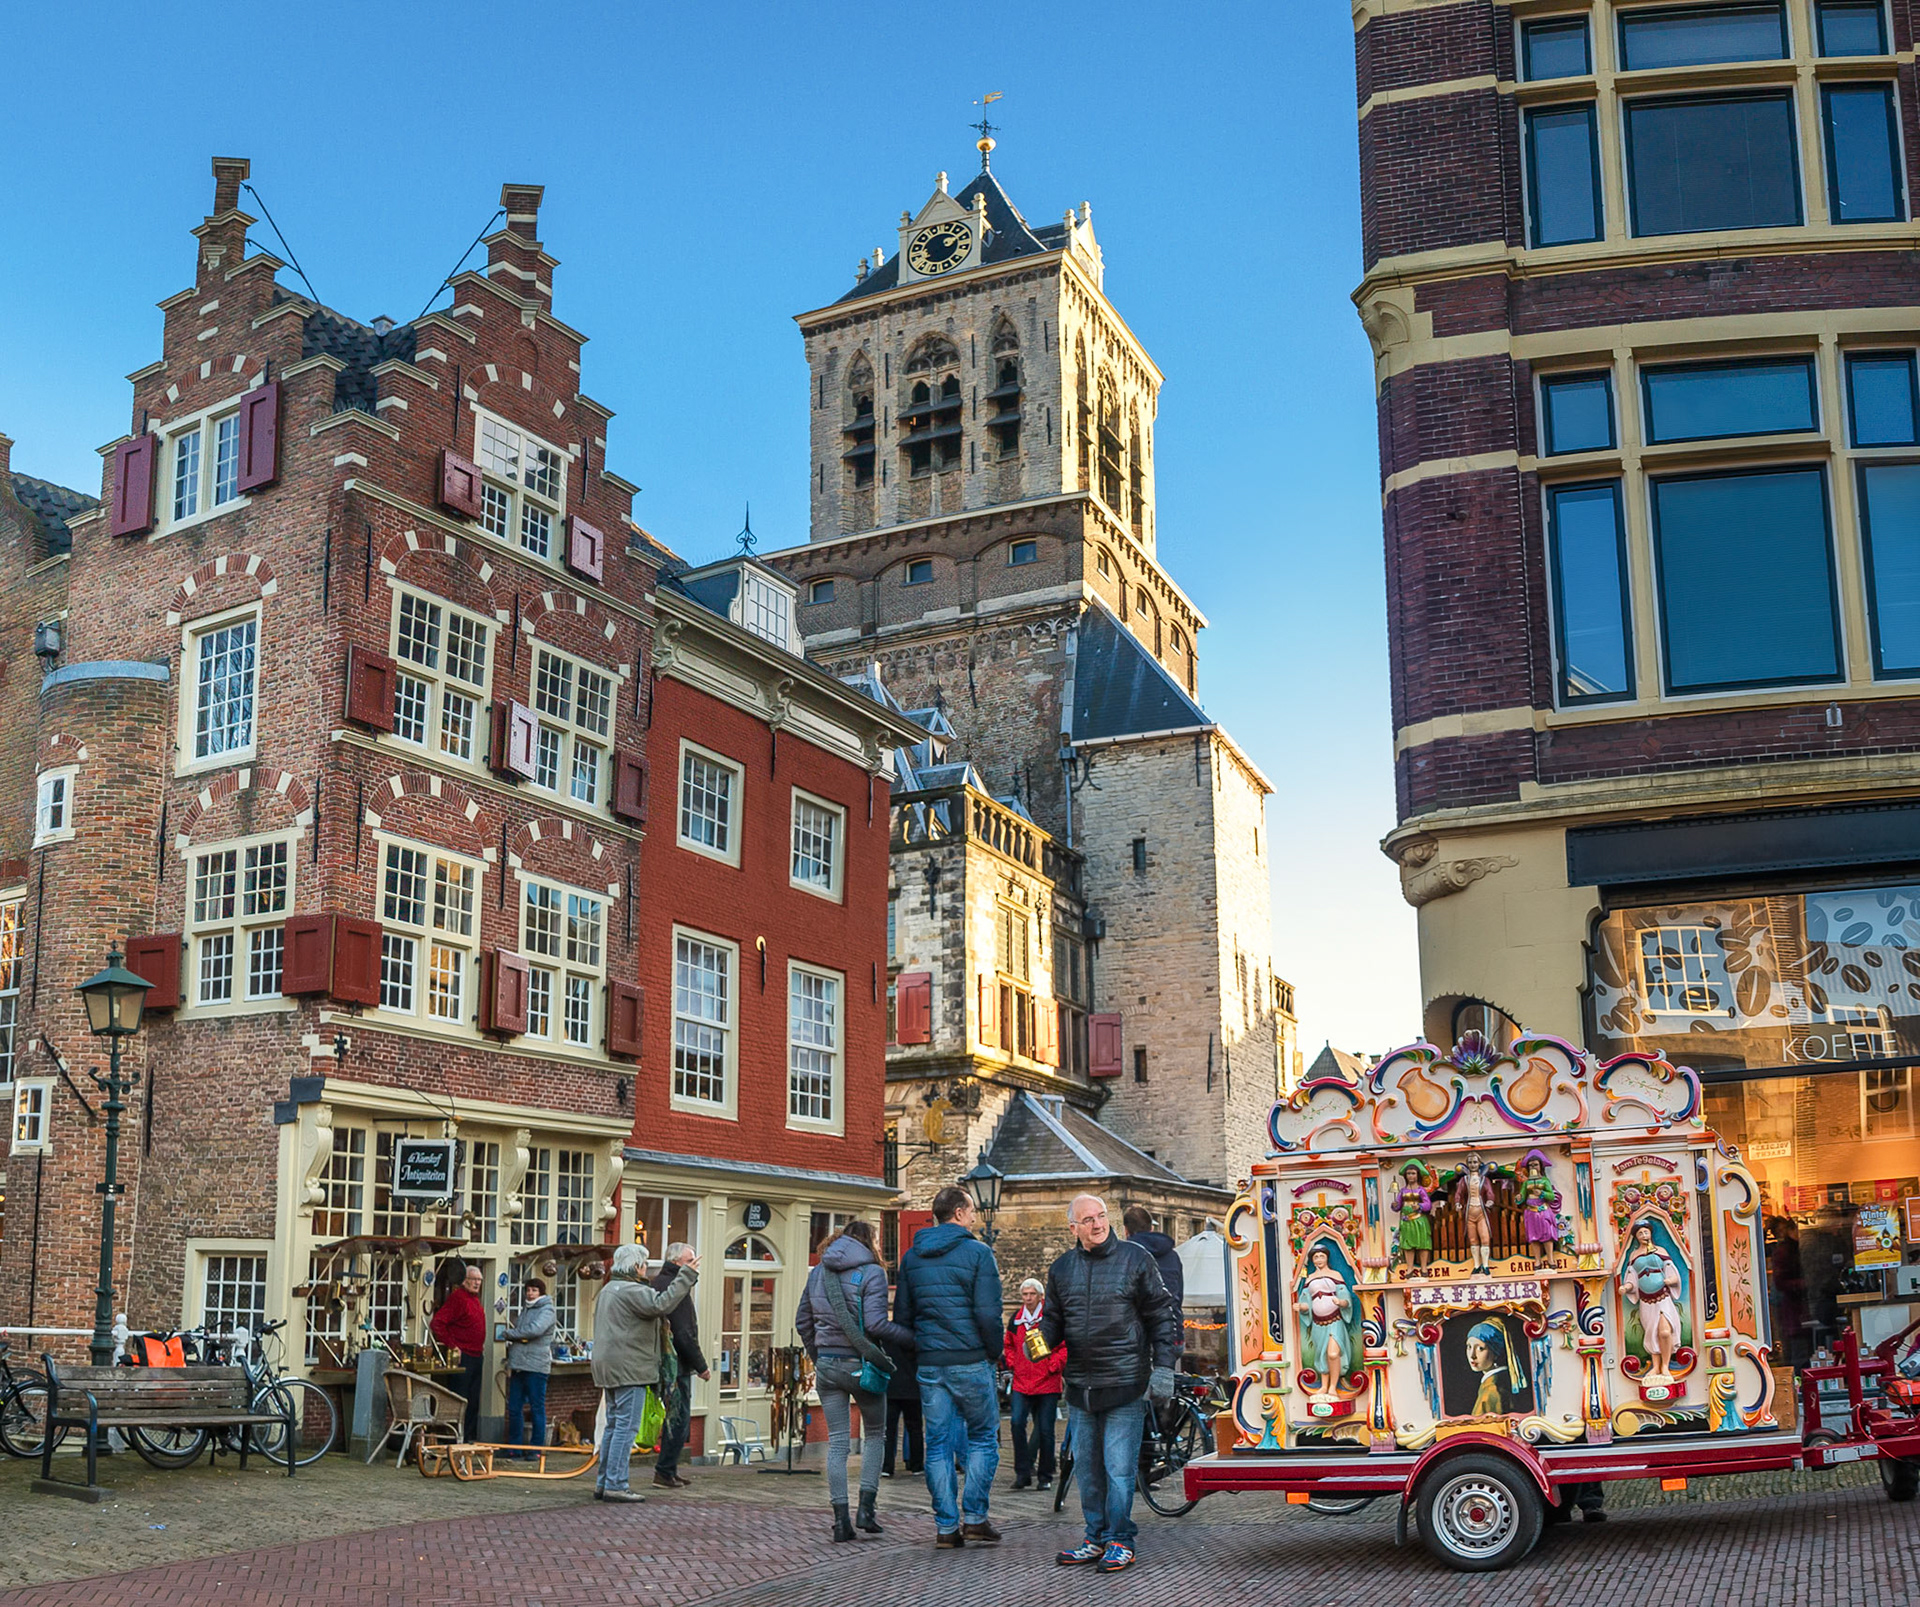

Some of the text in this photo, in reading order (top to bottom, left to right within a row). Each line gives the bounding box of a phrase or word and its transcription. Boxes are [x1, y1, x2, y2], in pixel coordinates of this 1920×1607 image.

[1782, 1030, 1898, 1062] KOFFIE
[1860, 1210, 1887, 1220] Winter
[1398, 1266, 1450, 1280] SSEEM
